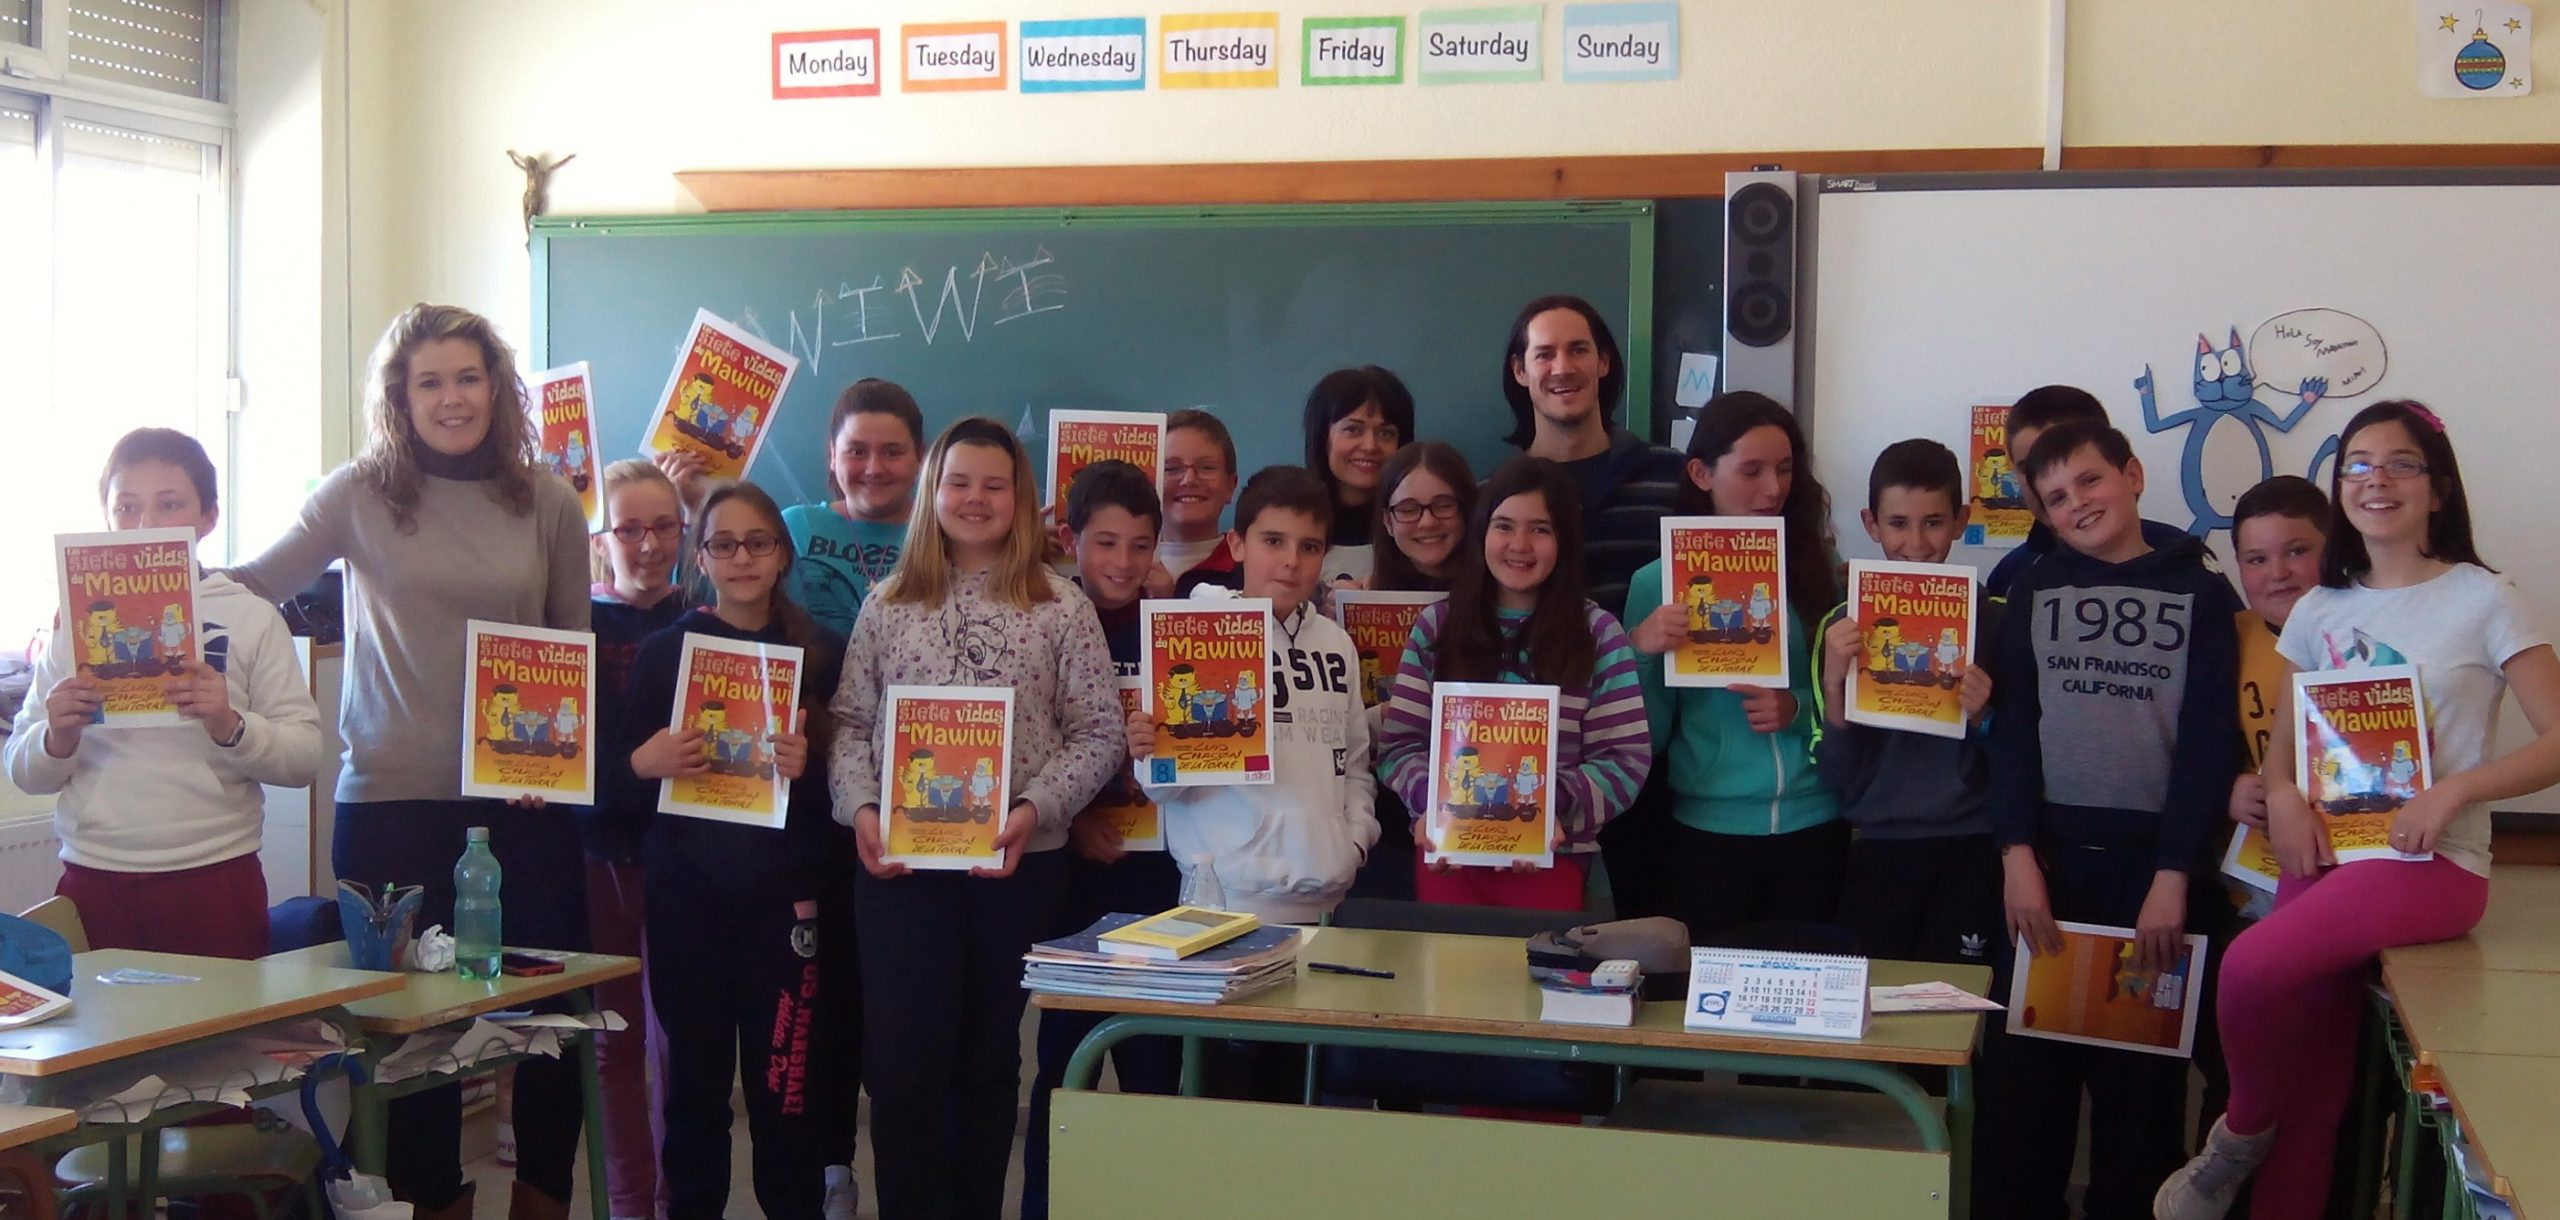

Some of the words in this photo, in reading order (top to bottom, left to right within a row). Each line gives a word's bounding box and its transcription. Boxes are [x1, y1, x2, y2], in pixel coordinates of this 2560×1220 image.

[916, 43, 996, 72] Tuesday
[1027, 45, 1136, 72] Wednesday
[1169, 38, 1267, 66] Thursday
[1318, 36, 1386, 67] Friday
[1428, 31, 1529, 61] Saturday
[1576, 34, 1661, 64] Sunday
[788, 50, 868, 75] Monday
[1827, 179, 1855, 189] SMART
[698, 330, 741, 362] siete
[743, 355, 784, 385] vidas
[700, 349, 779, 404] Mawiwi
[547, 381, 584, 404] vidas
[543, 402, 587, 426] wiwi
[1973, 408, 2010, 426] siet
[1061, 424, 1107, 444] siete
[1112, 426, 1157, 446] vidas
[1675, 531, 1725, 550] siete
[1729, 531, 1777, 552] vidas
[69, 549, 127, 572] siete
[133, 545, 189, 570] vidas
[1687, 550, 1777, 573] Mawiwi
[84, 567, 190, 597] Mawiwi
[1862, 574, 1915, 595] siete
[1919, 577, 1968, 600] vidas
[1874, 593, 1968, 619] Mawiwi
[1154, 615, 1209, 637] siete
[1213, 614, 1264, 637] vidas
[1358, 626, 1409, 648] Maw
[2043, 597, 2186, 652] 1985
[480, 638, 533, 660] siete
[537, 644, 587, 667] vidas
[1168, 636, 1264, 661] Mawiwi
[493, 658, 586, 688] Mawiwi
[694, 653, 746, 677] siete
[2047, 656, 2080, 671] SAN
[2085, 657, 2171, 680] FRANCISCO
[2062, 679, 2155, 701] CALIFORNIA
[2363, 682, 2413, 706] vidas
[899, 701, 950, 722] siete
[955, 702, 1004, 724] vidas
[1444, 698, 1495, 720] siete
[1499, 701, 1547, 722] vidas
[910, 722, 1003, 748] Mawiwi
[1456, 720, 1547, 746] Mawiwi
[1156, 763, 1171, 783] 8
